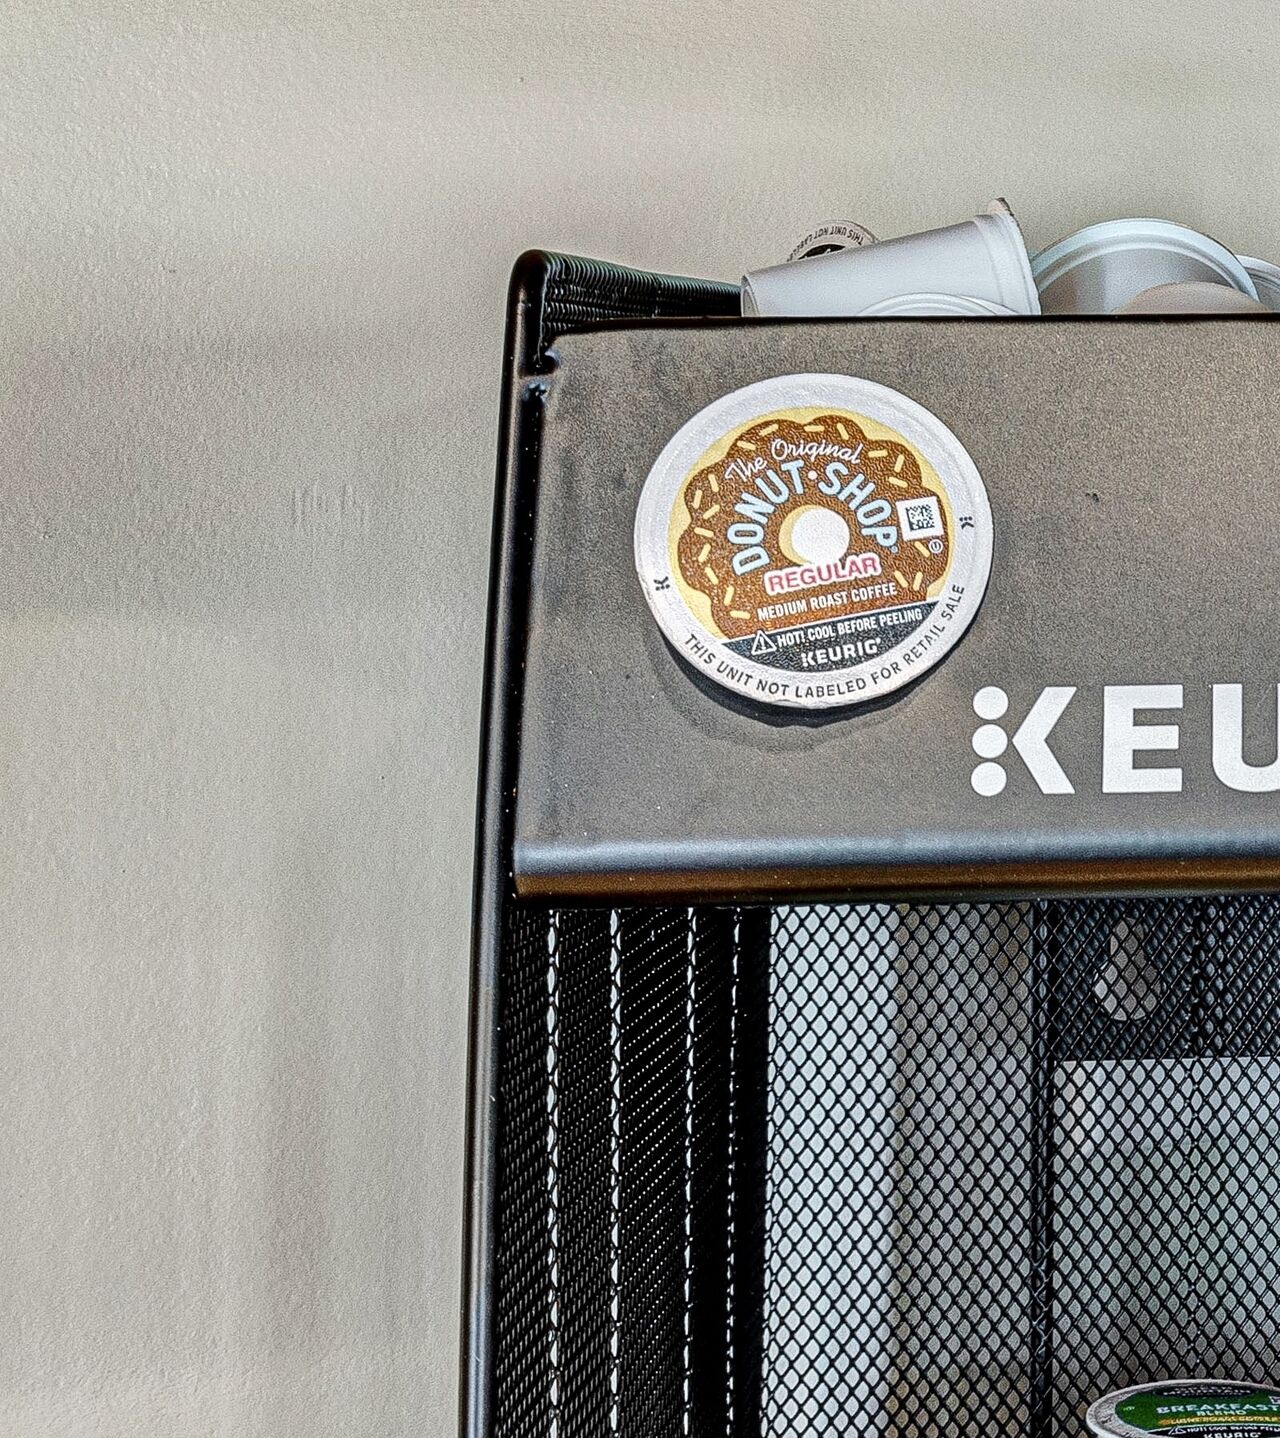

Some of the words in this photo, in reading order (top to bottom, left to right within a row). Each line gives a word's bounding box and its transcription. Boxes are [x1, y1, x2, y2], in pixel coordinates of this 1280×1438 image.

[725, 455, 767, 482] The
[771, 439, 864, 464] Original
[725, 460, 805, 575] DONUT
[817, 463, 898, 554] SHOP
[768, 555, 878, 593] REGULAR
[757, 599, 808, 620] MEDIUM
[810, 591, 849, 610] ROAST
[852, 583, 896, 602] COFFEE
[685, 634, 713, 664] THIS
[718, 659, 753, 687] UNIT
[756, 679, 790, 698] NOT
[795, 679, 866, 699] LABELED
[872, 661, 902, 685] FOR
[903, 625, 945, 666] RETAIL
[941, 583, 965, 620] SALE
[777, 630, 805, 648] HOT!
[807, 625, 835, 643] COOL
[838, 617, 877, 637] BEFORE
[879, 608, 922, 630] PEELING
[800, 636, 881, 667] KEURIG
[1156, 1403, 1279, 1414] BREAKFAST
